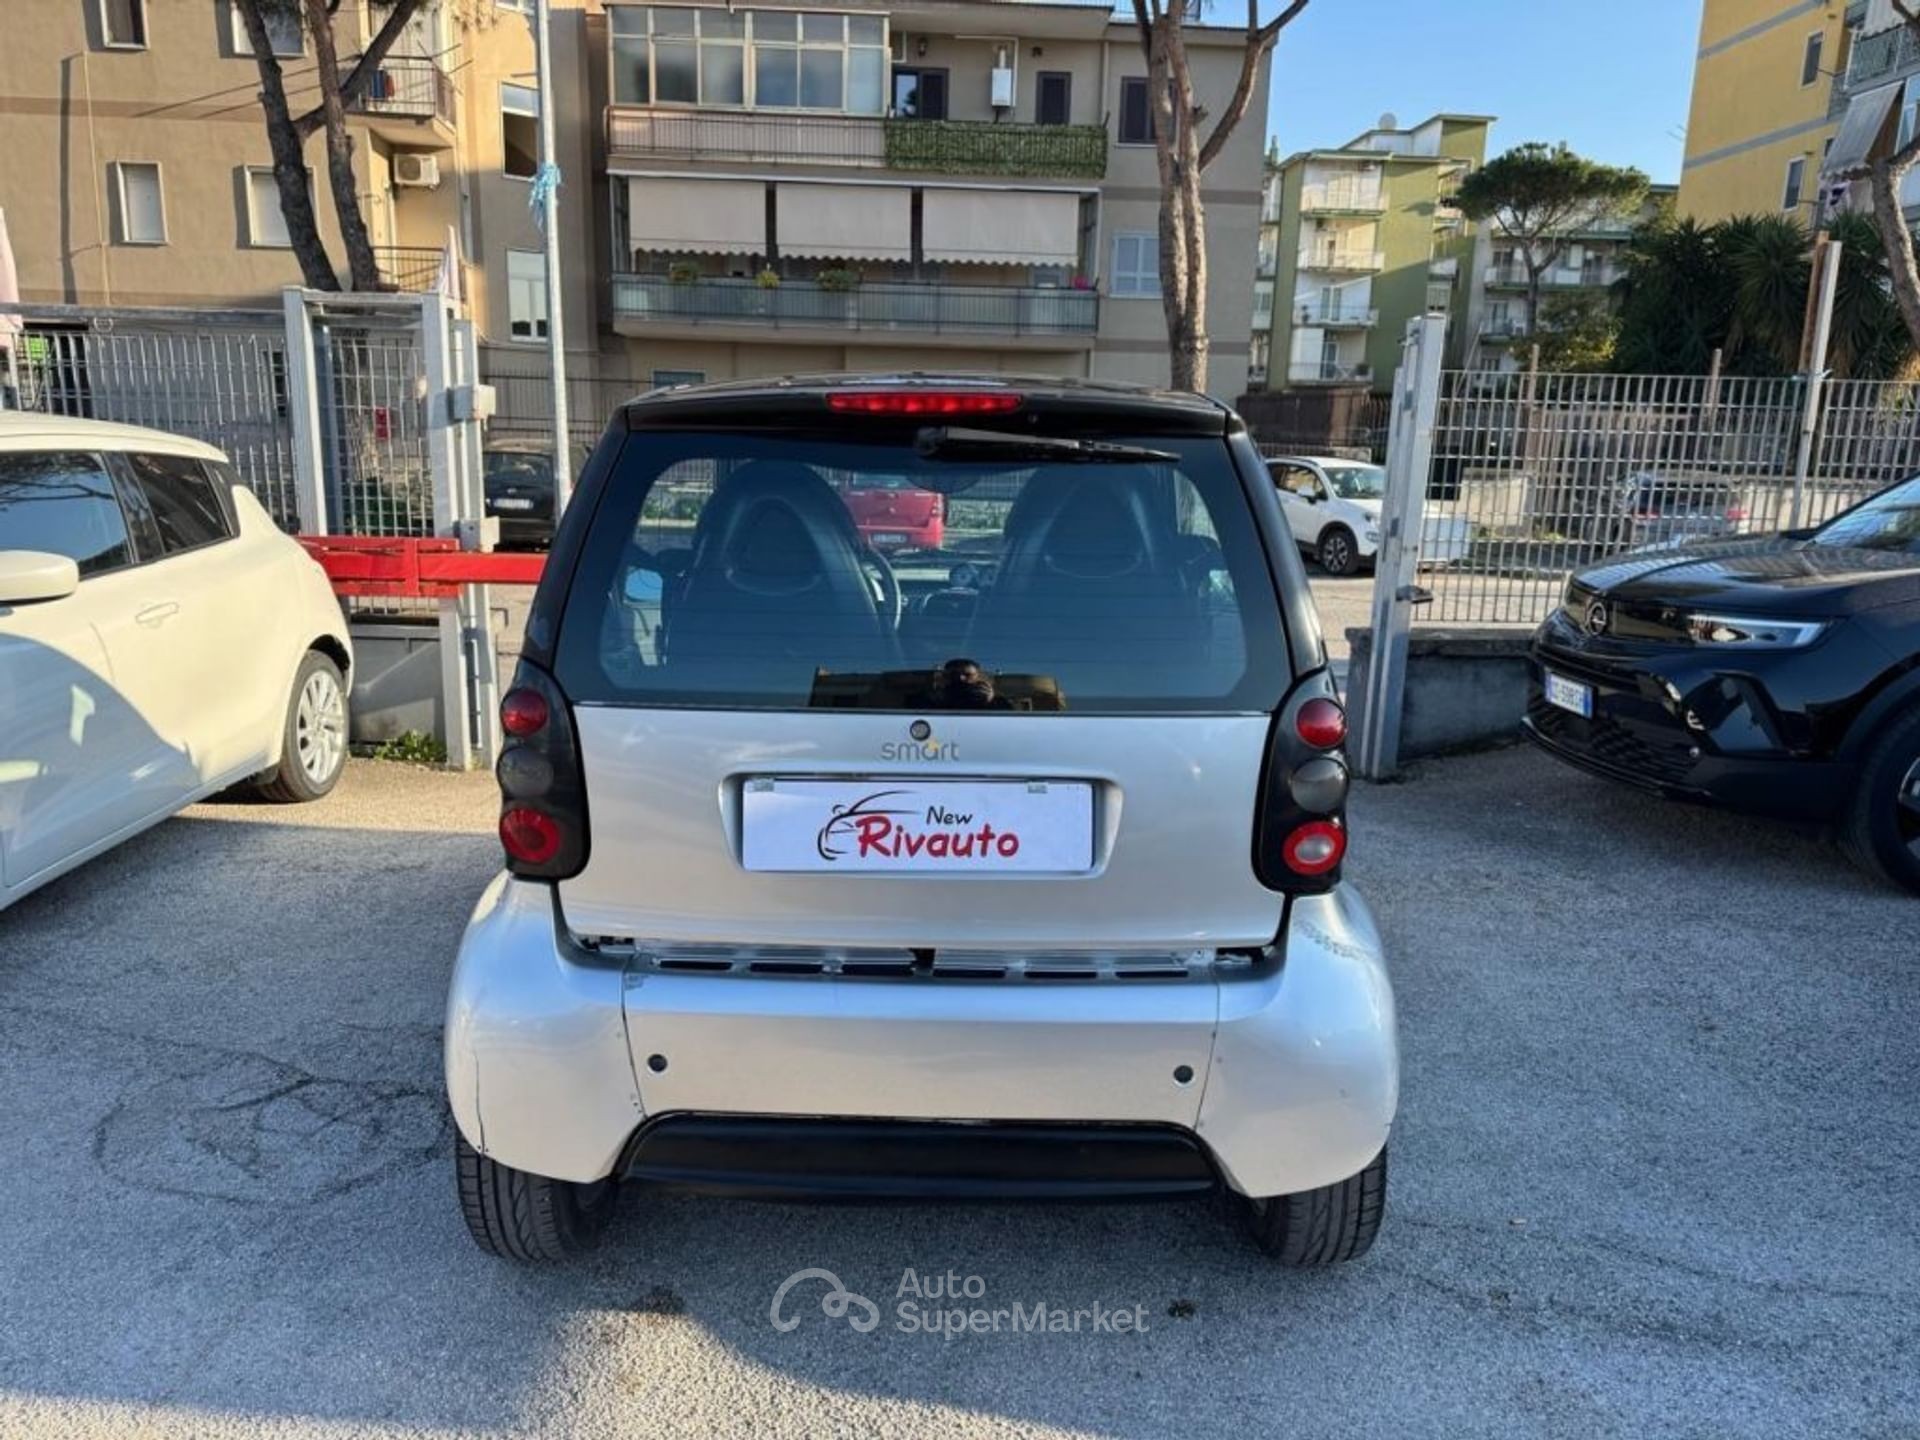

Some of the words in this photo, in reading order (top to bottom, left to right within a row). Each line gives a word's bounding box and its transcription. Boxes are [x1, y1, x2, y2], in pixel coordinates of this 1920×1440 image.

[881, 741, 960, 761] smart
[926, 805, 973, 825] New
[855, 815, 1019, 858] Rivauto
